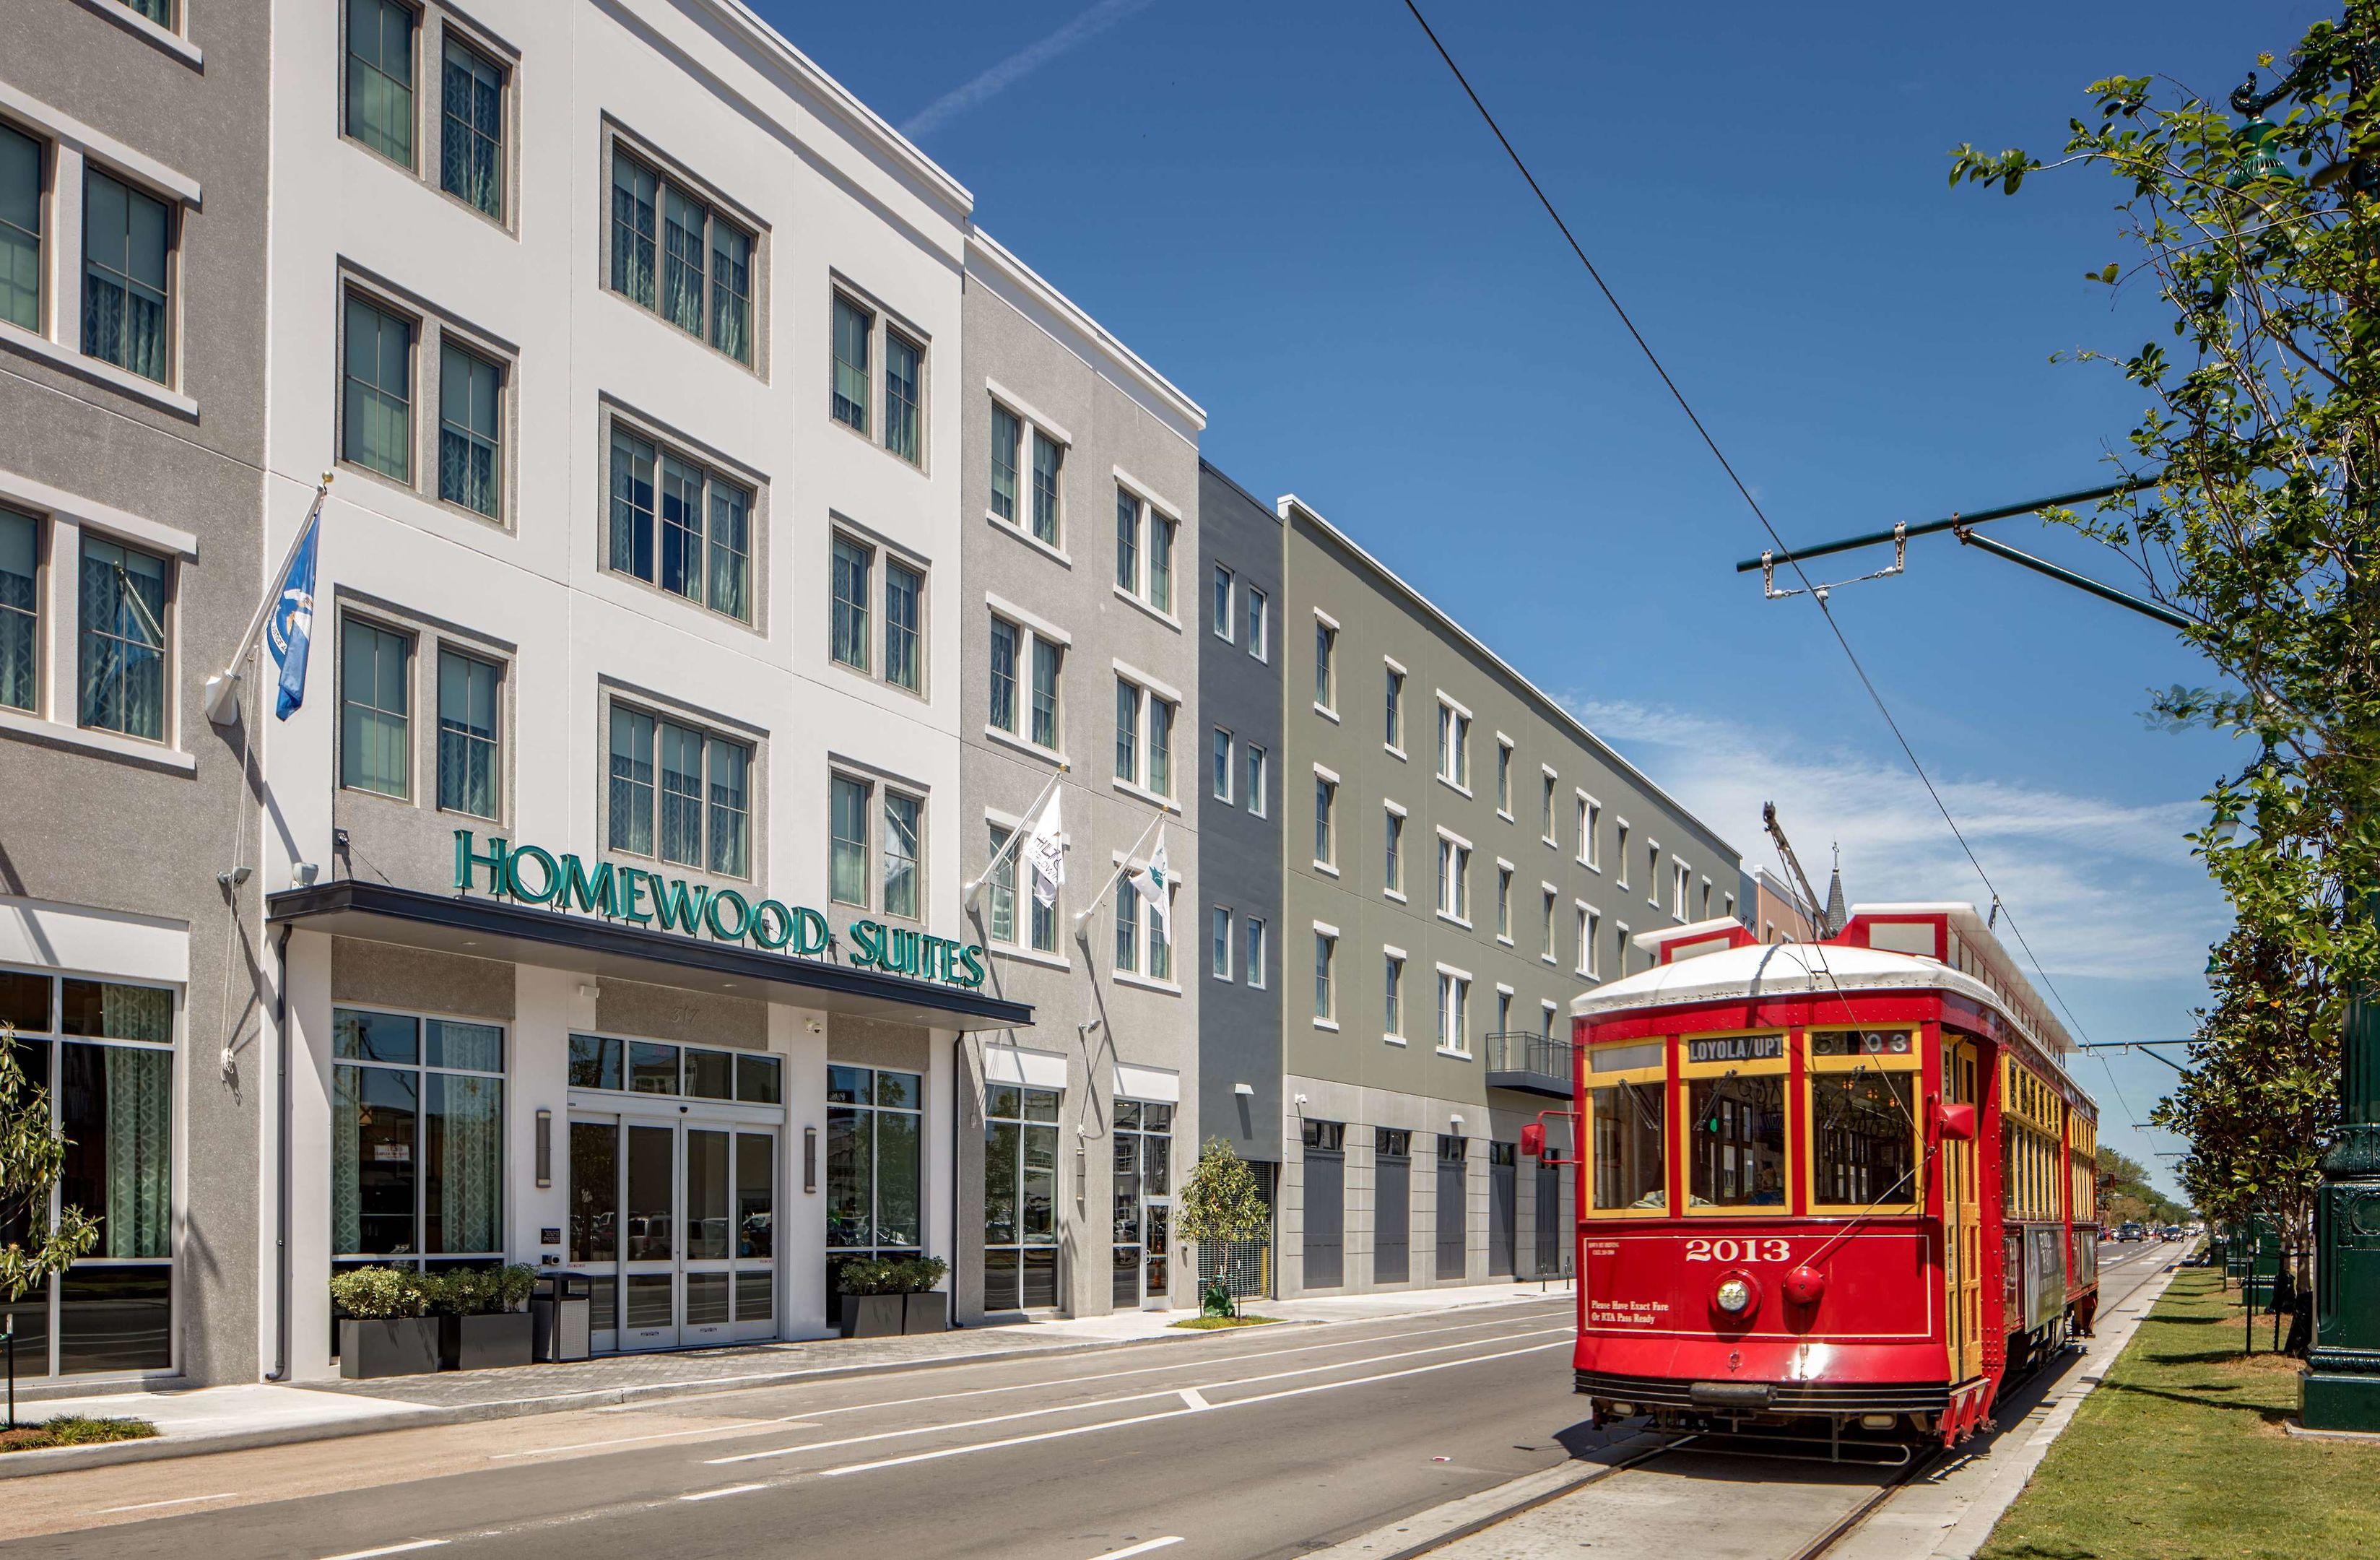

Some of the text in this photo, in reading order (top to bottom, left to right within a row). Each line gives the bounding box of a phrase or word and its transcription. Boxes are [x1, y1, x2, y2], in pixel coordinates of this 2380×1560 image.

[453, 828, 984, 988] HOMEWOOD SUITES
[672, 1005, 699, 1024] 317
[1685, 1239, 1791, 1262] 2013
[1591, 1300, 1669, 1312] Please Have Exact Fare
[1591, 1312, 1656, 1325] Or RTA Pass Ready
